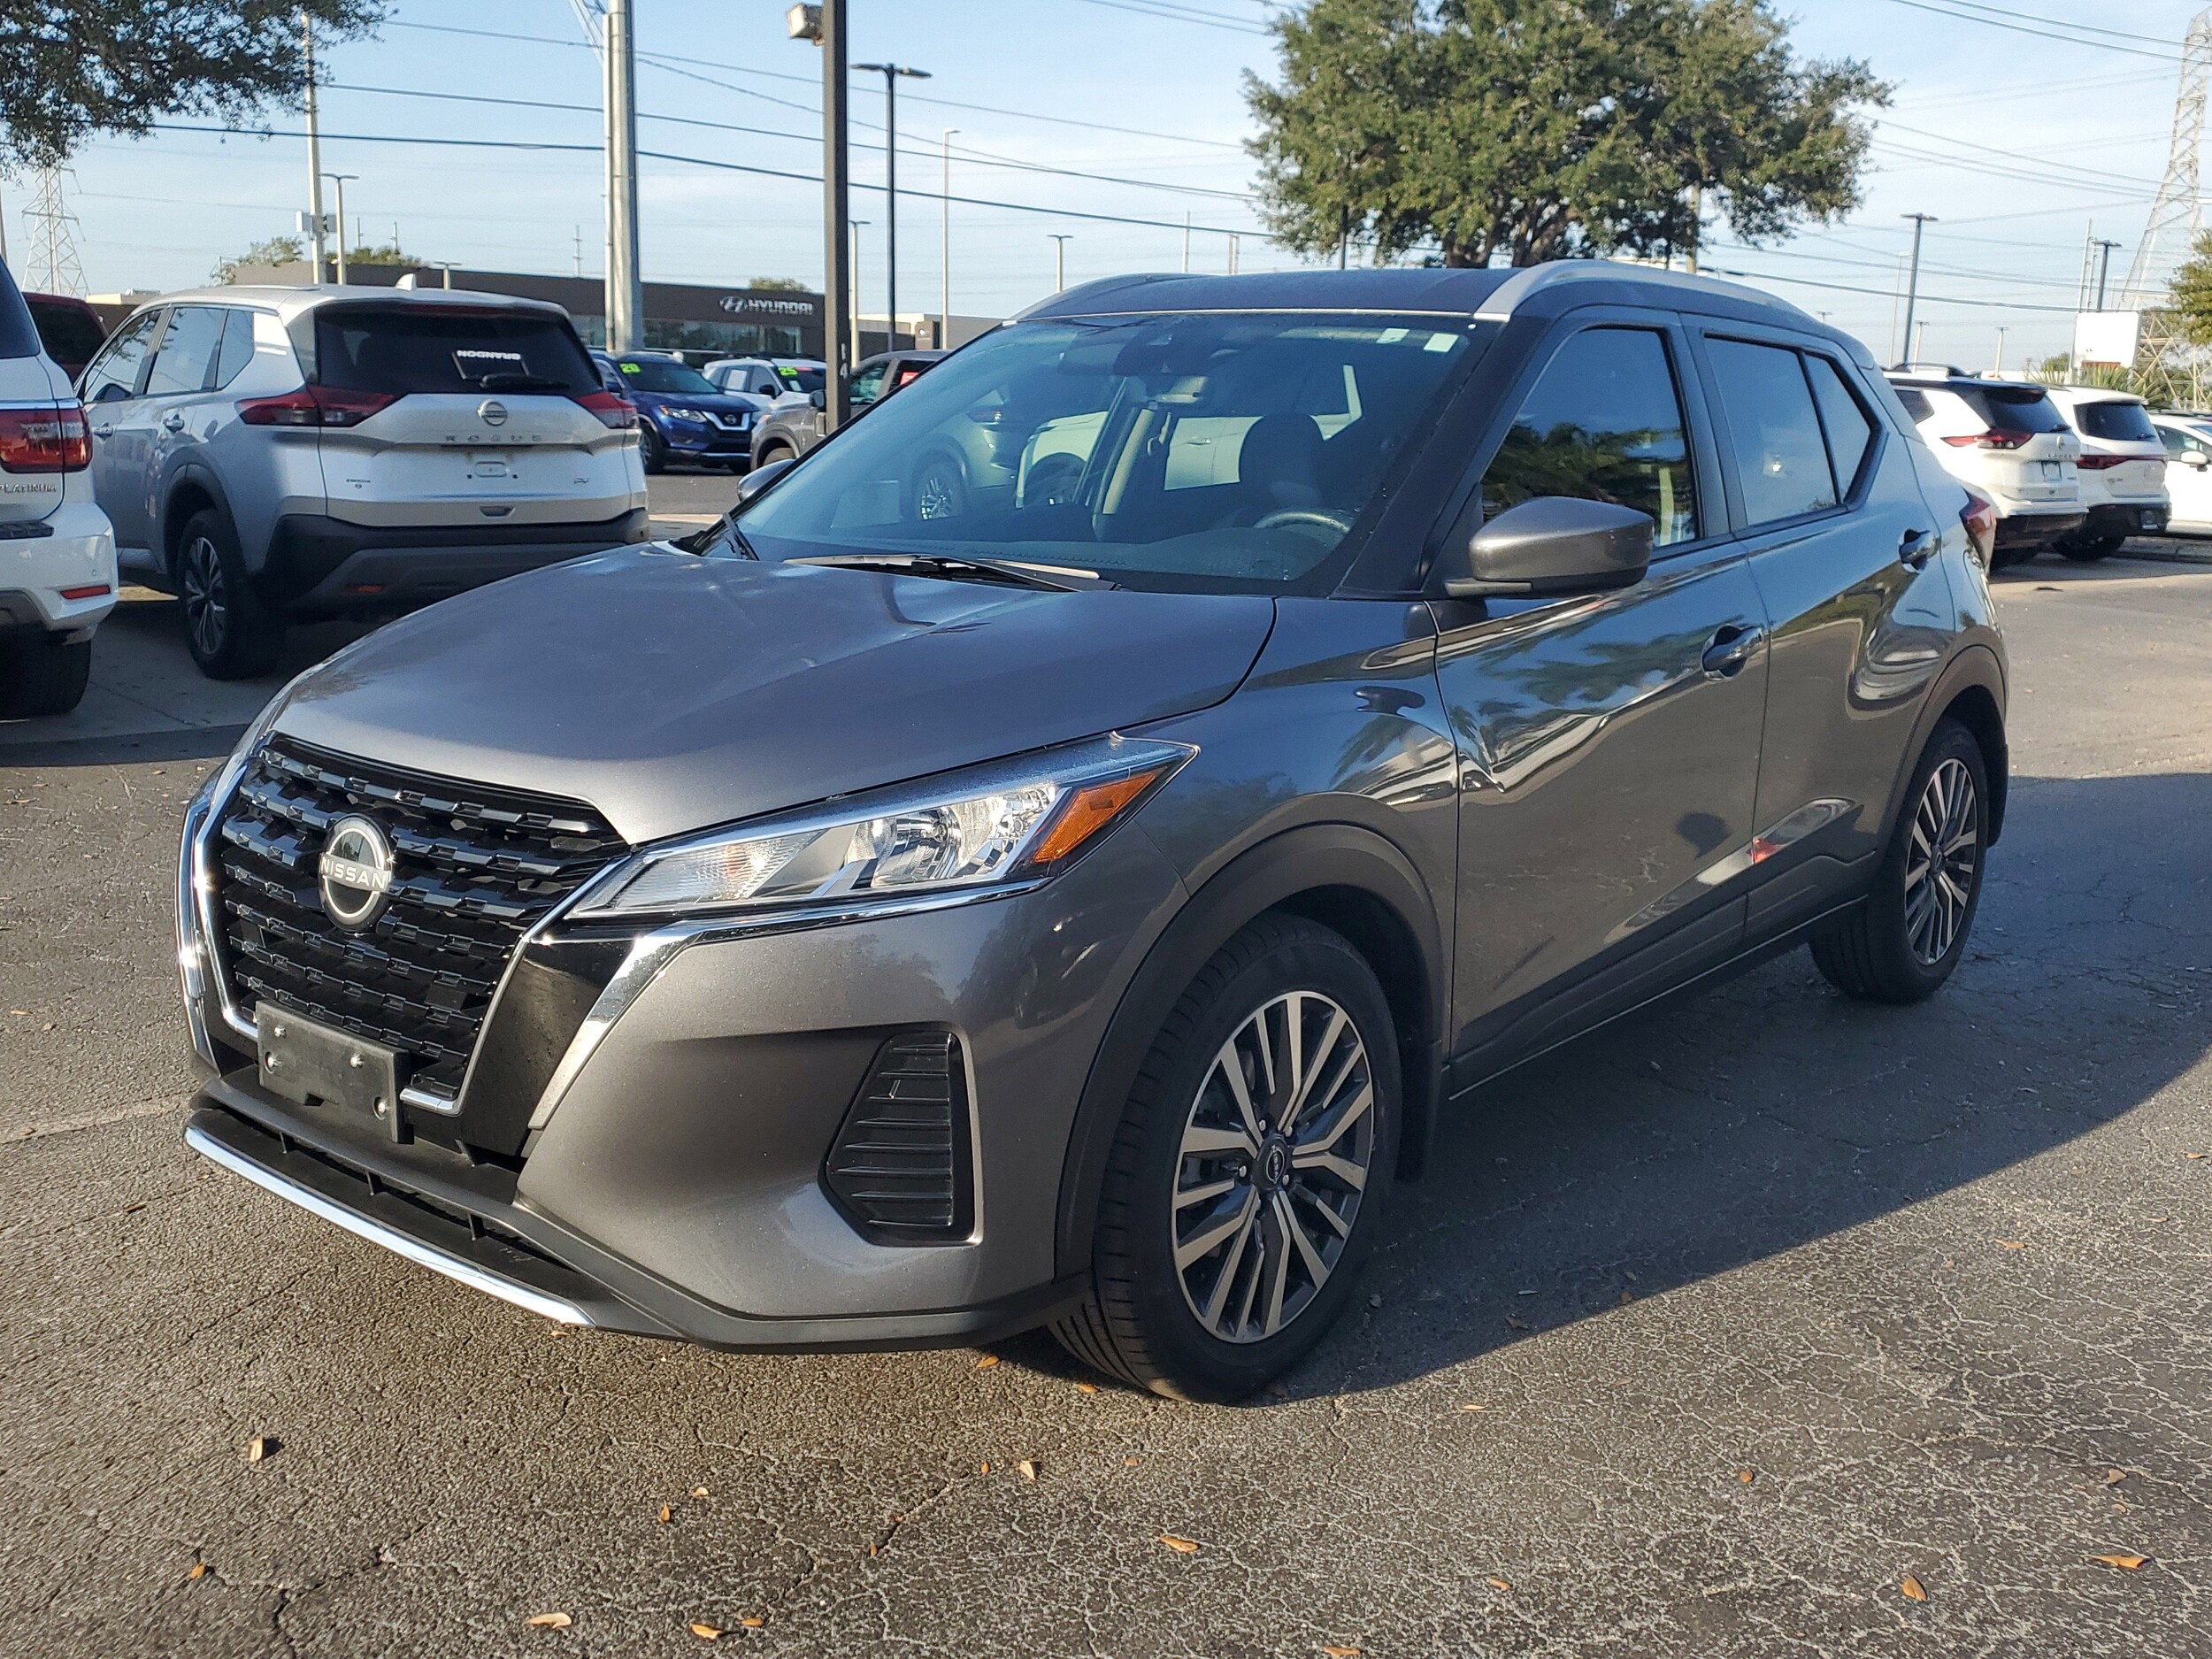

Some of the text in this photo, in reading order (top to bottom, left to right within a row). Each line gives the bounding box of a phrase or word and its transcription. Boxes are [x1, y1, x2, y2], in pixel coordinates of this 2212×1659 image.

[748, 299, 813, 315] HYUNDAI
[619, 363, 641, 373] 20
[320, 856, 387, 889] NISSAN
